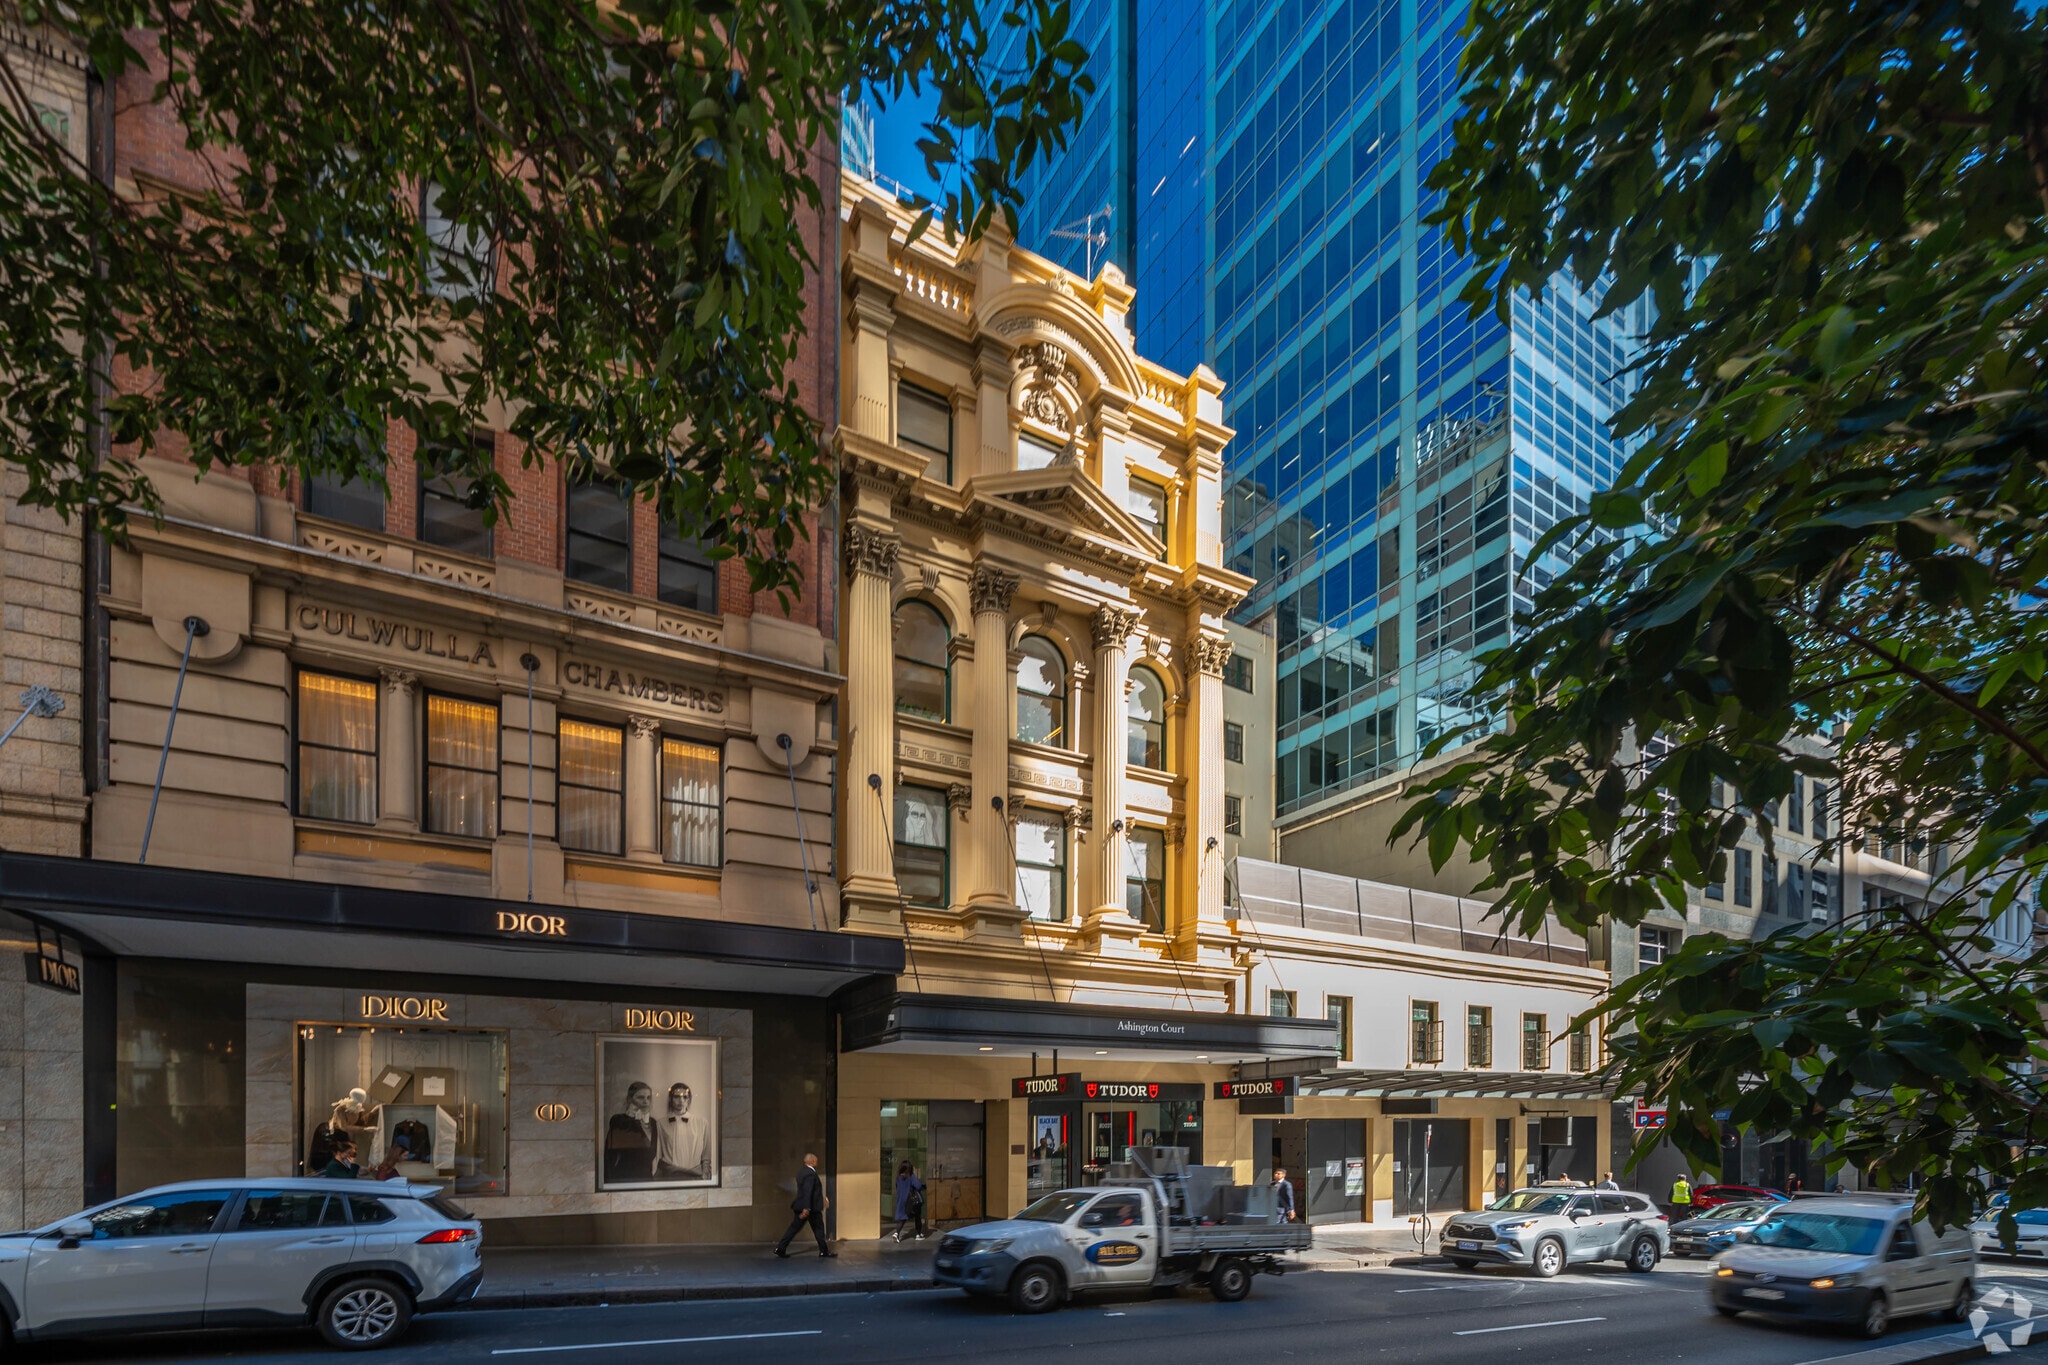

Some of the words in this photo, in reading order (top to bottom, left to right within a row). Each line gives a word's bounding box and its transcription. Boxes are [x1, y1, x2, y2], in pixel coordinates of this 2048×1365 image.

[297, 604, 497, 669] CULWULLA
[563, 659, 725, 714] CHAMBERS
[495, 911, 568, 937] DIOR
[41, 958, 79, 991] DIOR
[361, 994, 450, 1022] DIOR
[625, 1007, 696, 1032] DIOR
[1117, 1020, 1159, 1035] Ashington
[1160, 1023, 1185, 1034] Court
[1025, 1078, 1058, 1094] TUDOR
[1100, 1084, 1148, 1097] TUDOR
[1231, 1082, 1274, 1095] TUDOR
[1640, 1116, 1648, 1124] P
